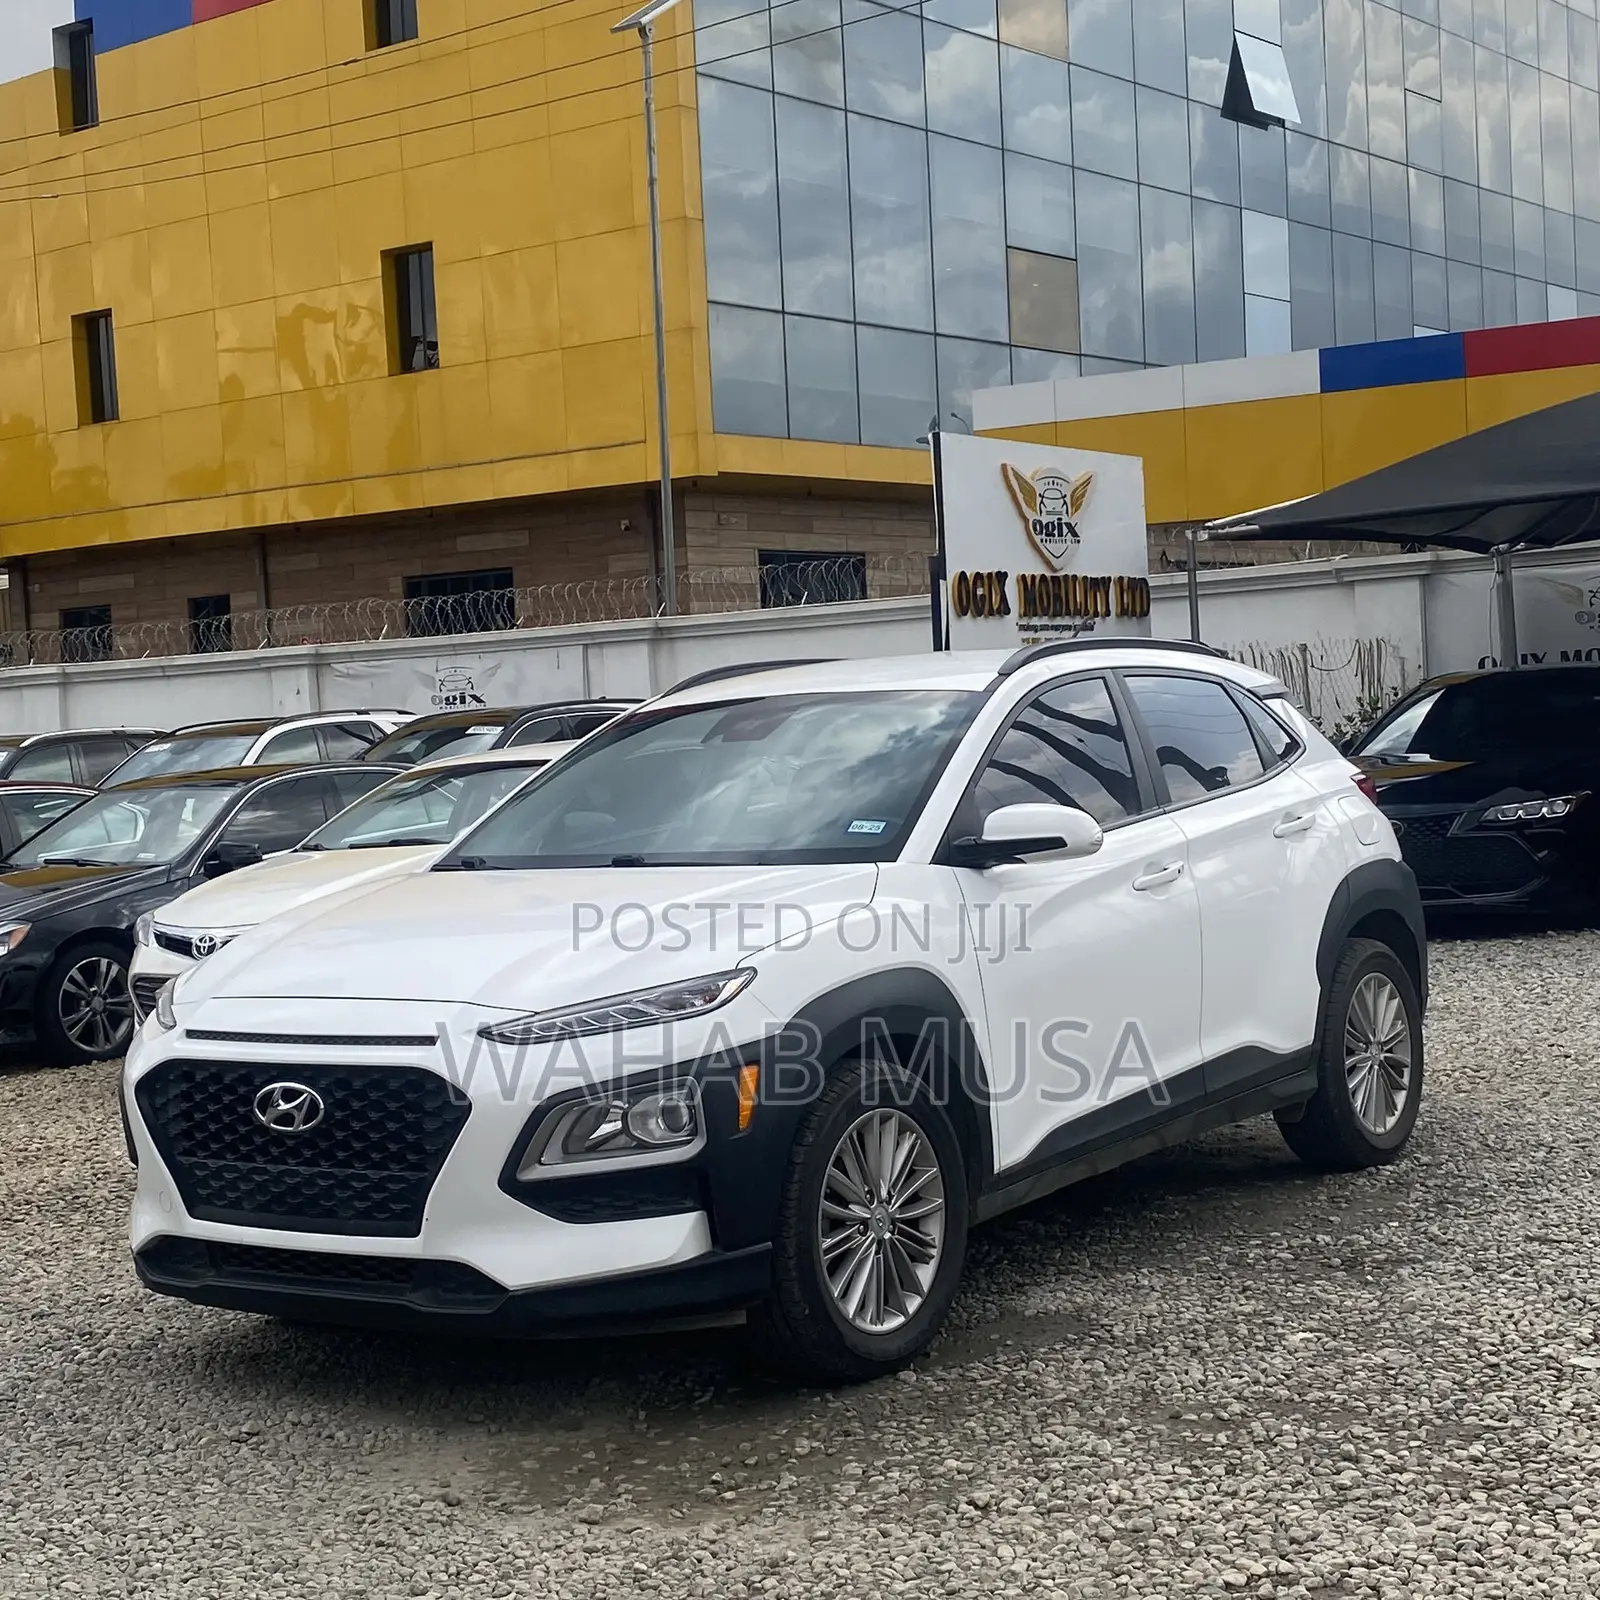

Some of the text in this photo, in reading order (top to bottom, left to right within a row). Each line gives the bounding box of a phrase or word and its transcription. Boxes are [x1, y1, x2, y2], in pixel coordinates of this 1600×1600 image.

[953, 570, 1150, 618] OGIX MOBILITY LTD
